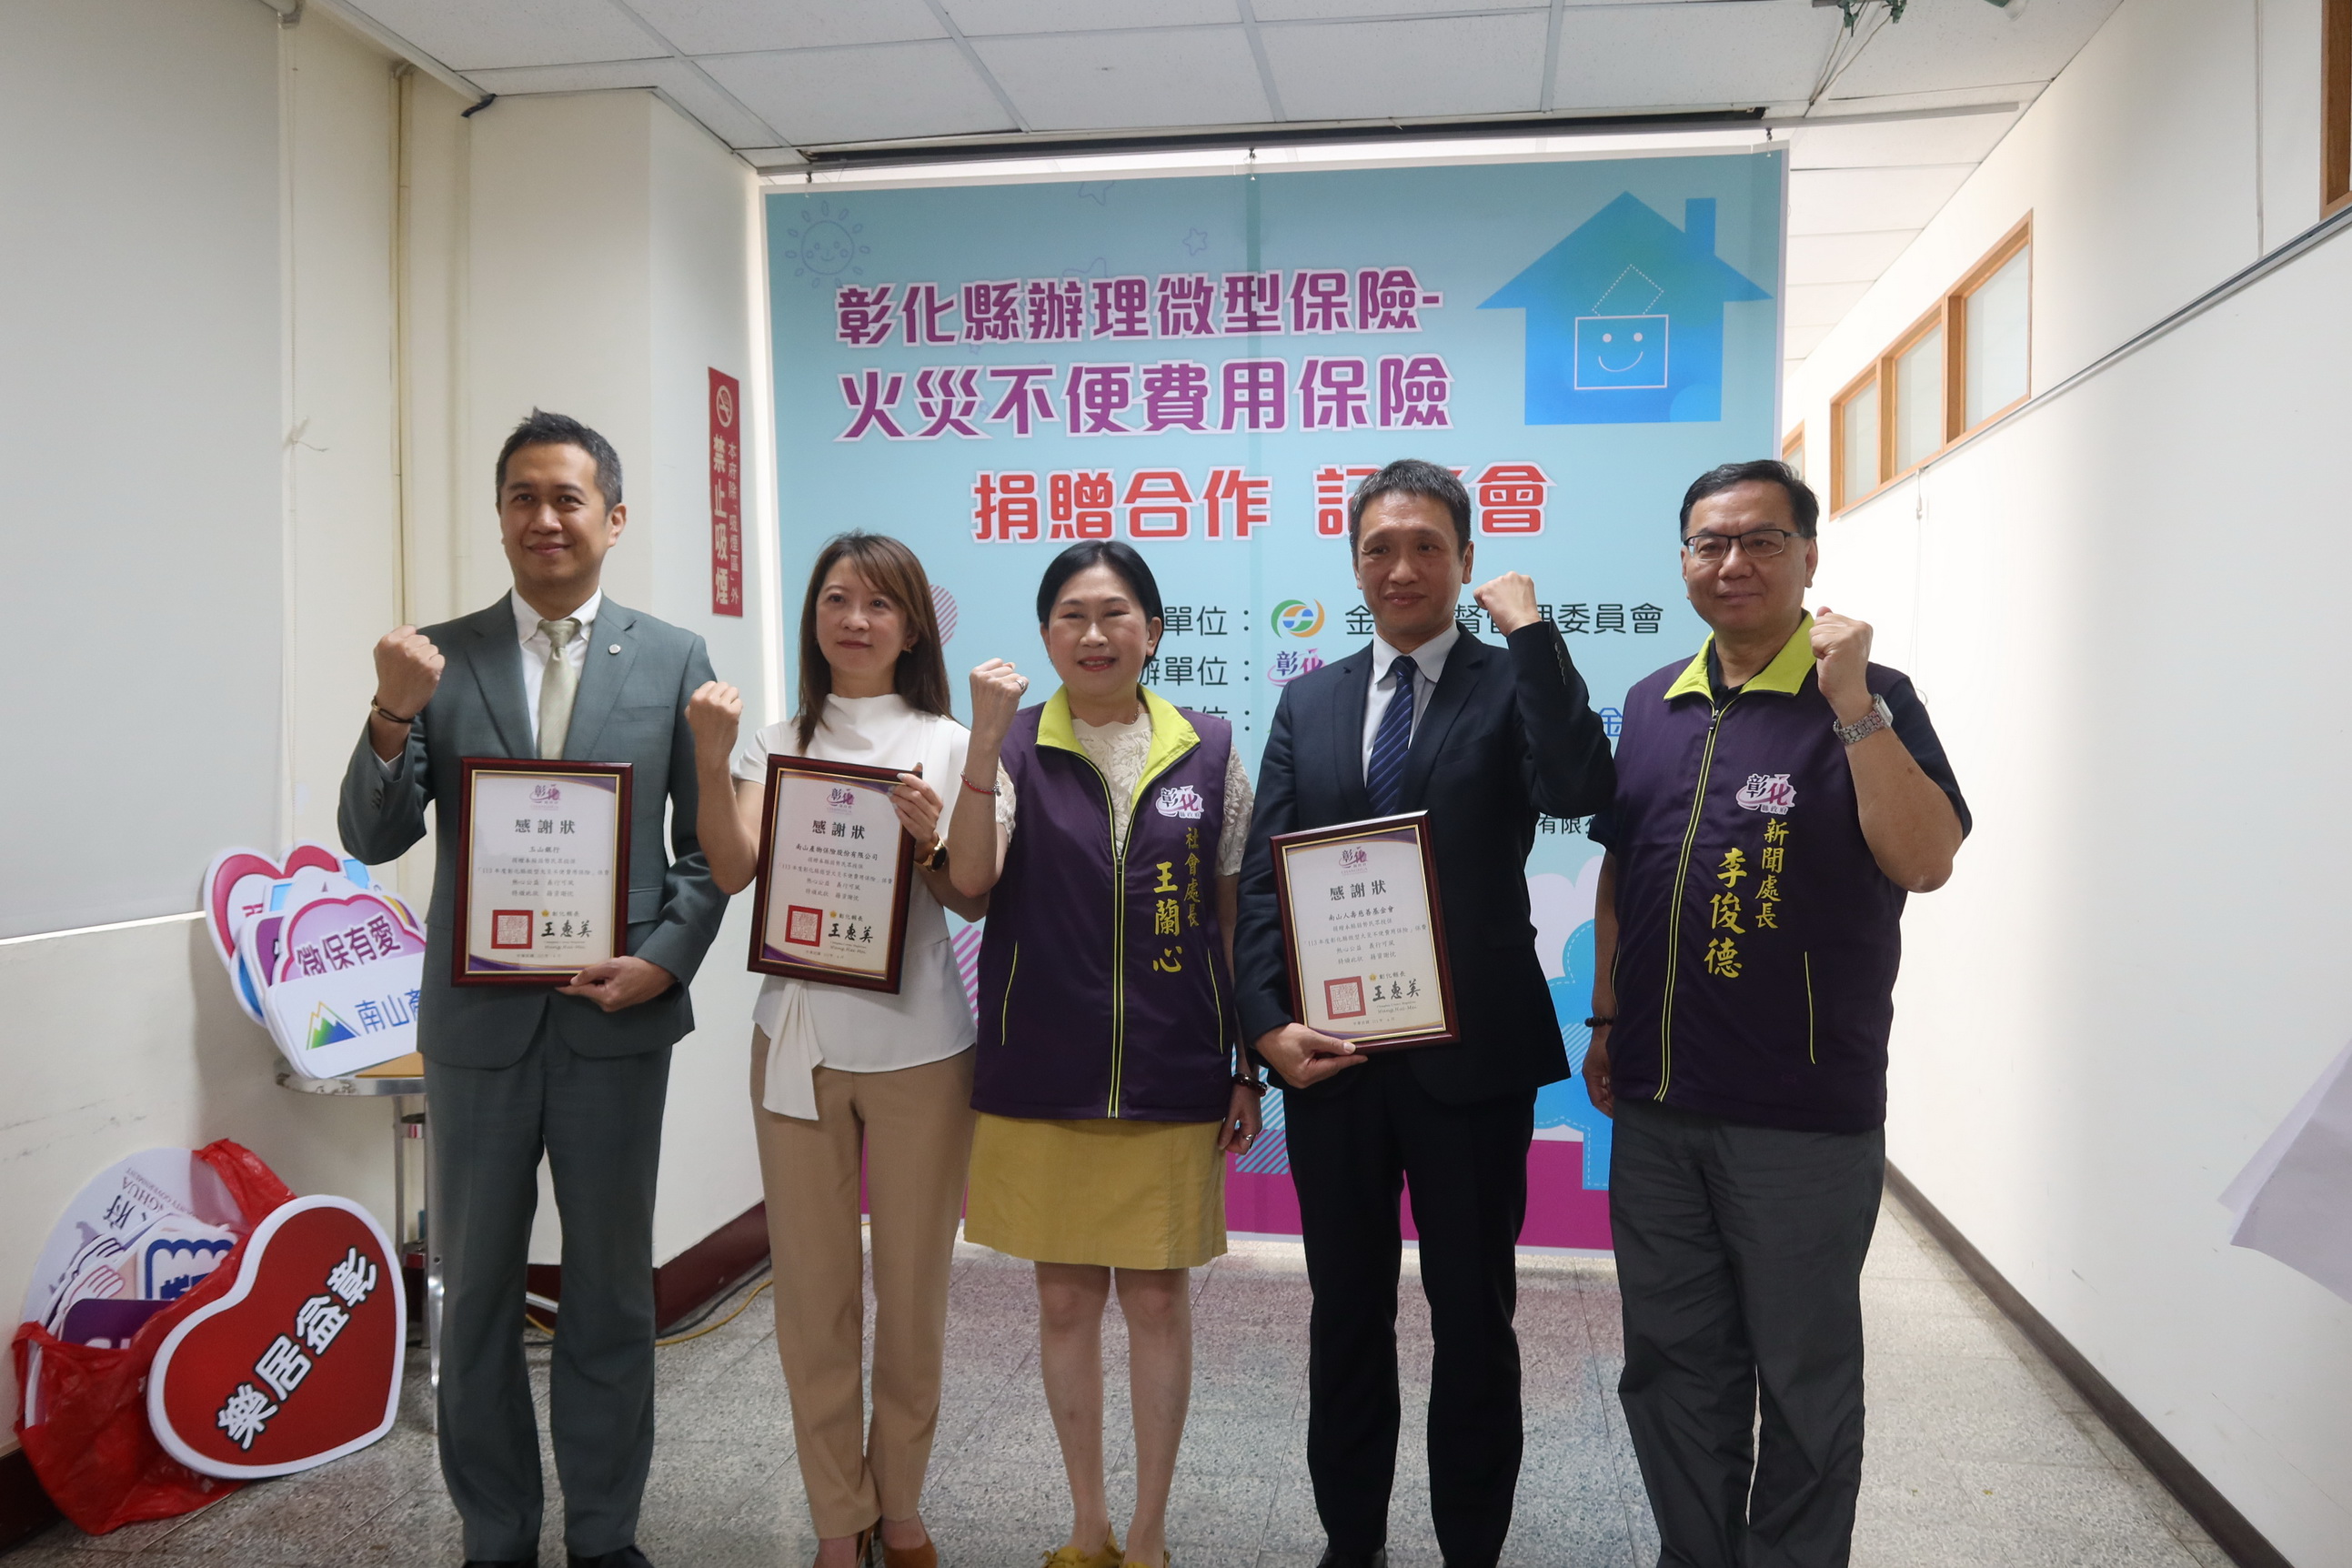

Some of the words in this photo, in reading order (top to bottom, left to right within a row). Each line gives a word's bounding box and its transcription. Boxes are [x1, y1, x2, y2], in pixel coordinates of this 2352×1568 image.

[837, 268, 1441, 346] 彰化縣辦理微型保險-
[840, 357, 1450, 439] 火災不便費用保險
[973, 468, 1270, 540] 捐贈合作
[1316, 465, 1550, 535] 記會
[1745, 774, 1792, 807] 彰化
[514, 819, 577, 835] 感謝狀
[811, 819, 866, 840] 感謝狀
[1183, 827, 1201, 928] 社會處長
[1329, 879, 1387, 901] 感謝狀
[1754, 817, 1790, 930] 新聞處長
[297, 914, 401, 977] 微保有愛
[828, 922, 874, 944] 王惠美
[1152, 860, 1183, 974] 王蘭心
[1704, 847, 1748, 980] 李俊德
[1372, 978, 1422, 1002] 王惠美
[122, 1176, 165, 1213] GHUA
[217, 1247, 377, 1451] 樂居益彰
